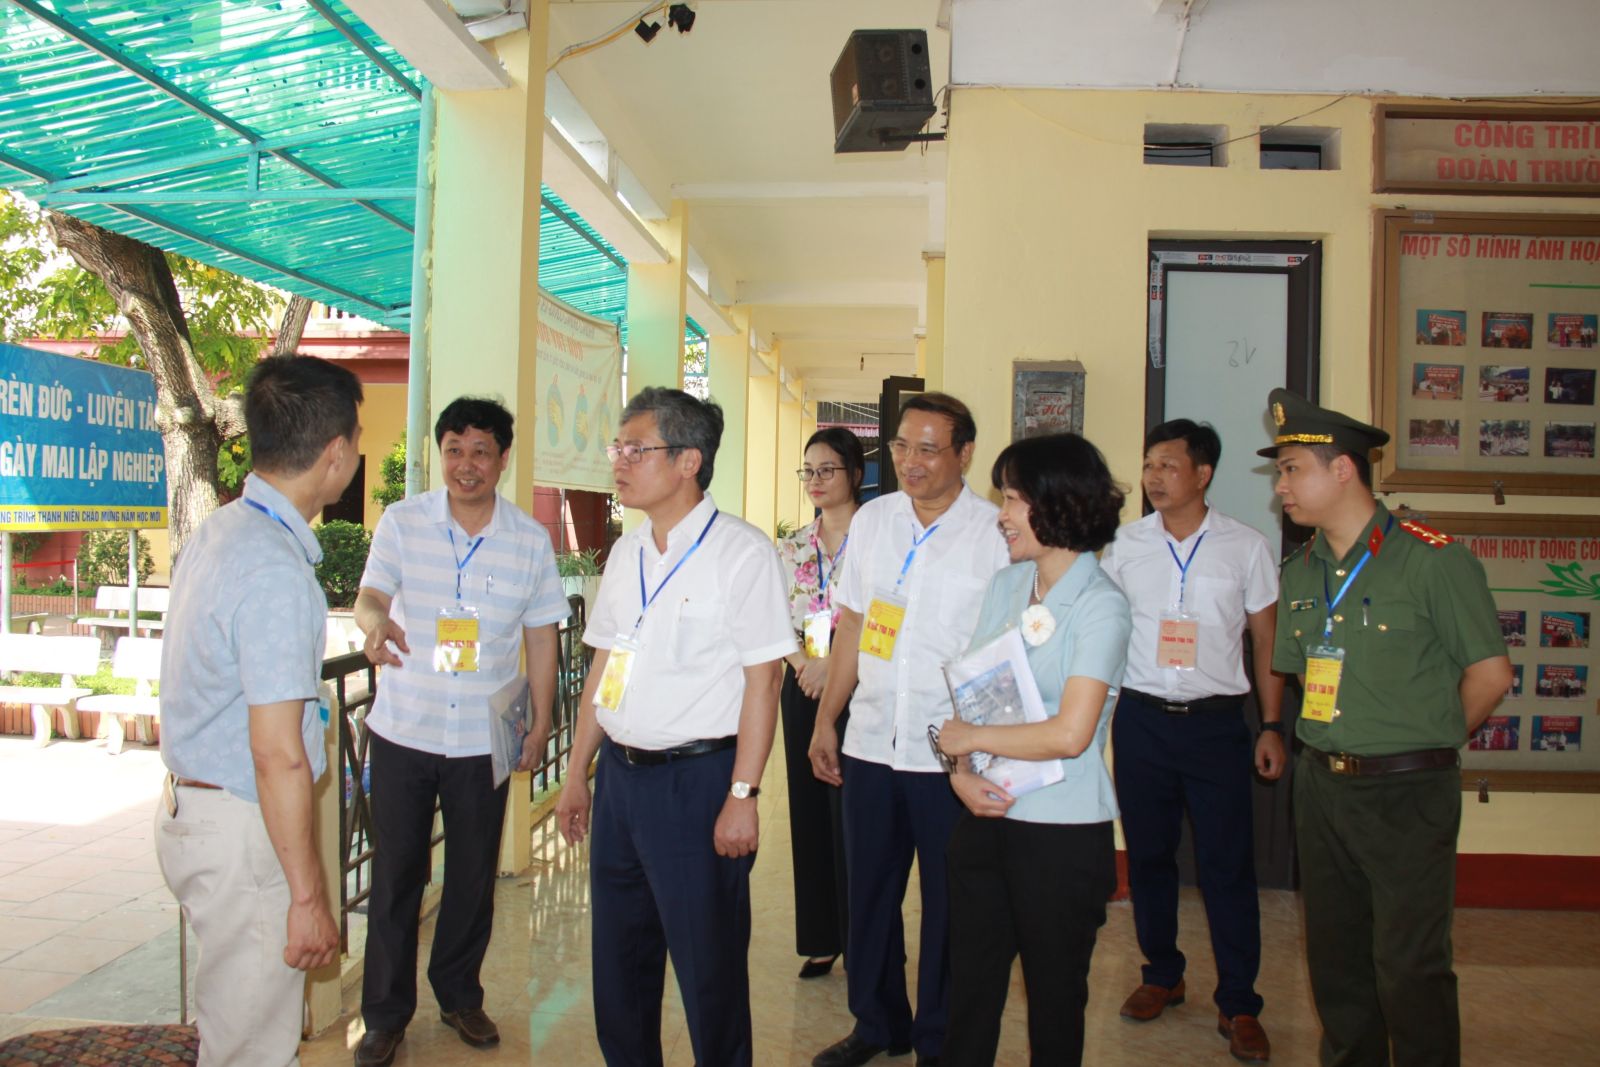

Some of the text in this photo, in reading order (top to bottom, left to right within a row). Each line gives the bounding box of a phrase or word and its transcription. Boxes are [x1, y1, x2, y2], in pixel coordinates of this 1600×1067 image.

[1454, 120, 1535, 149] CÔNG
[1437, 154, 1518, 182] ĐOÀN
[1401, 232, 1442, 260] MỘT
[1475, 233, 1521, 259] HÌNH
[38, 380, 72, 422] ĐỨC
[88, 391, 134, 434] LUYỆN
[42, 444, 75, 480] MAI
[79, 441, 109, 487] LẬP
[112, 448, 164, 489] NGHIỆP
[38, 511, 61, 523] THANH
[63, 508, 80, 522] NIÊN
[1501, 539, 1537, 563] HOẠT
[1540, 537, 1577, 563] ĐỘNG
[1580, 536, 1600, 560] CÔ
